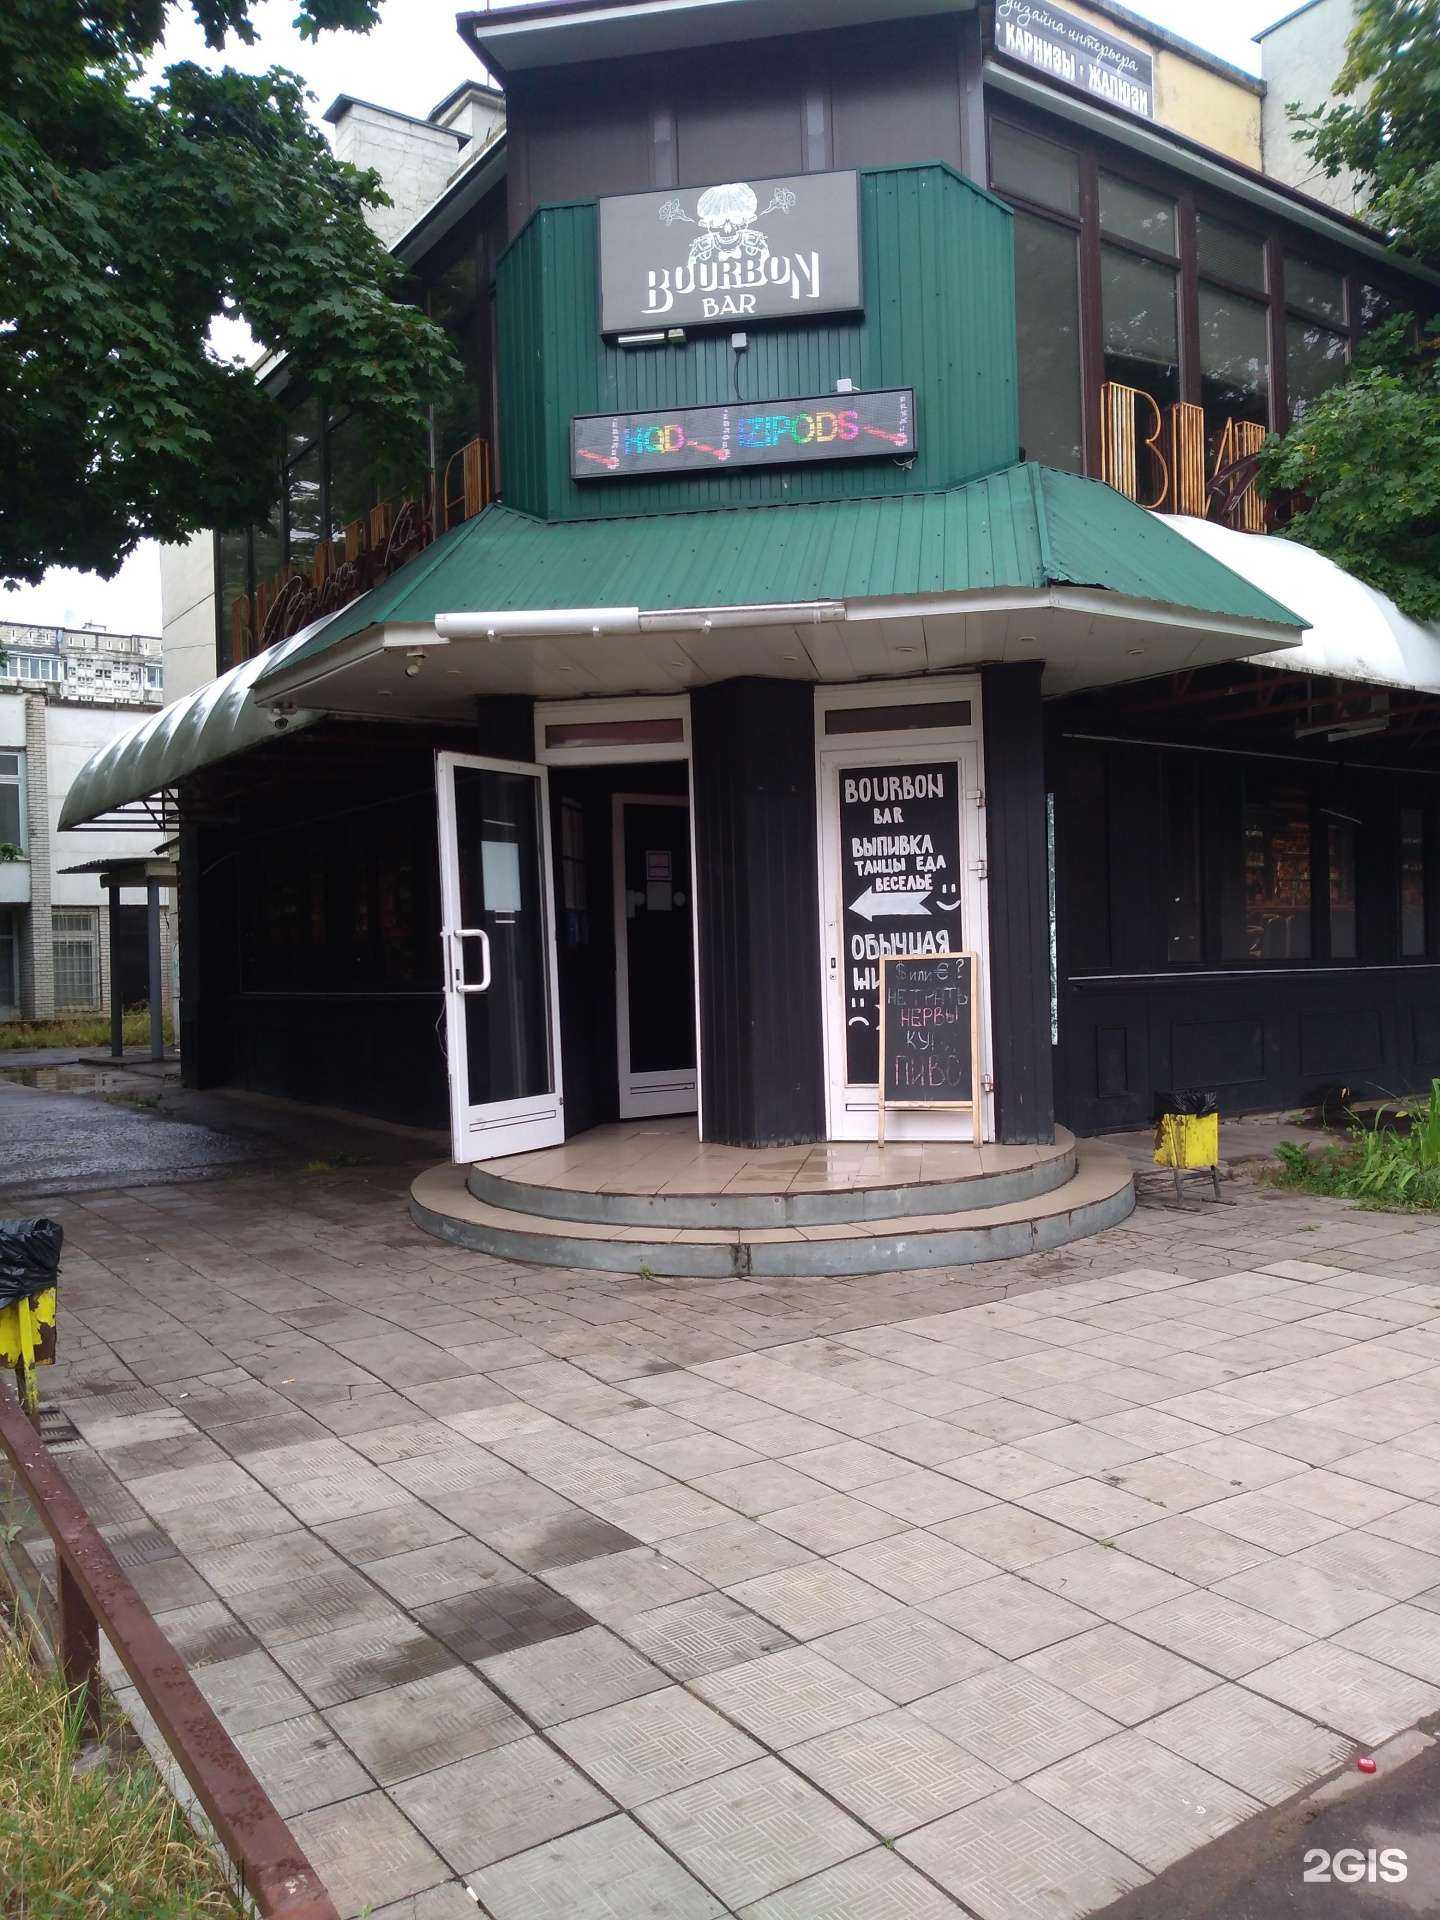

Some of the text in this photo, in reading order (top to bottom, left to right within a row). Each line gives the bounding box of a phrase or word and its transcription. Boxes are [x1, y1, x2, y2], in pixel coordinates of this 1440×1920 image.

[1068, 29, 1139, 75] интерьера
[1005, 21, 1149, 116] КАРНИЗЫ ЖАЛЮЗИ
[641, 250, 820, 314] BOURBON
[702, 294, 757, 318] BAR
[844, 773, 944, 803] BOURBON
[873, 807, 904, 825] BAR
[851, 834, 934, 858] ВЫПИВКА
[854, 855, 947, 877] ТАНЦЫ ЕДА
[875, 874, 934, 893] ВЕСЕЛЬЕ
[851, 929, 950, 960] ОБЫЧНАЯ
[900, 1004, 959, 1027] НЕРВЫ
